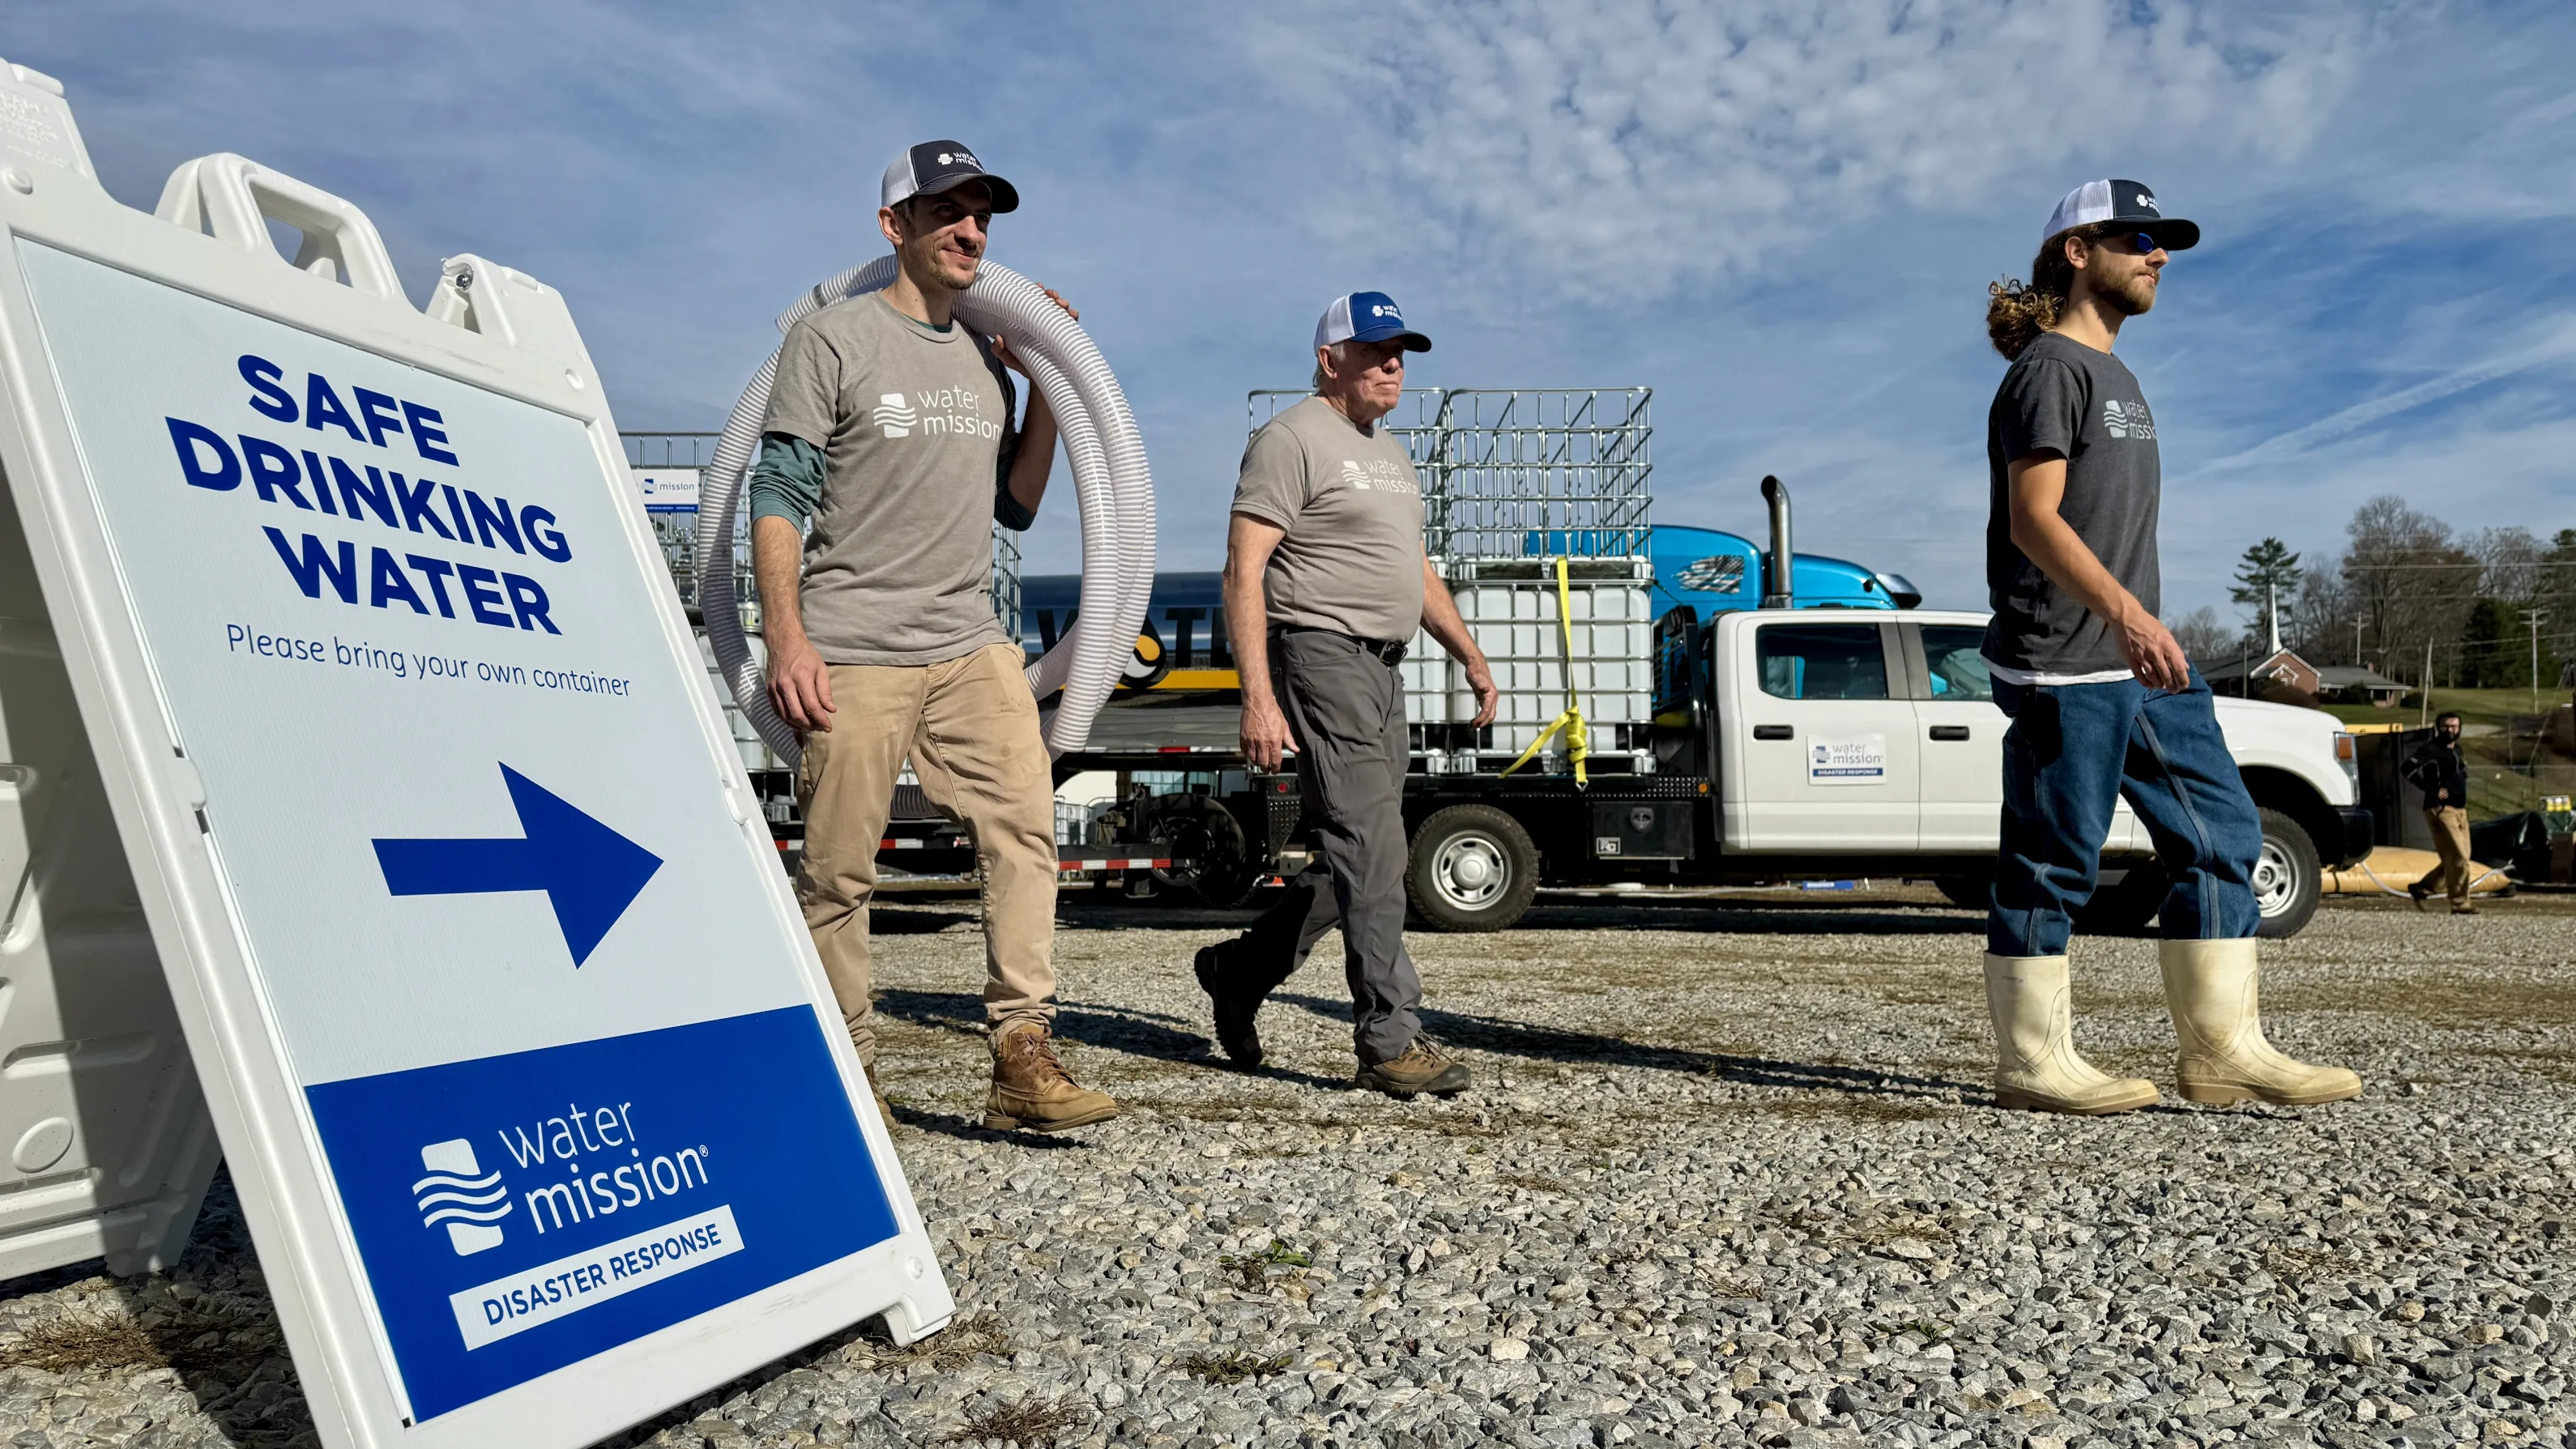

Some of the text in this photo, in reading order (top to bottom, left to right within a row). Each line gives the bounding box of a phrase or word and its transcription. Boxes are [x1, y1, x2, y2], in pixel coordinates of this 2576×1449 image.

[237, 354, 460, 467] SAFE
[917, 385, 979, 411] water
[2121, 399, 2148, 420] water
[923, 409, 1000, 442] mission
[2129, 419, 2156, 440] missi
[1363, 458, 1402, 477] water
[165, 416, 573, 564] DRINKING
[659, 482, 695, 491] mission
[1374, 475, 1419, 496] missio
[262, 526, 563, 636] WATER
[227, 624, 630, 697] Please bring your own container
[1832, 743, 1866, 753] water
[498, 1102, 636, 1169] water
[482, 1222, 723, 1326] DISASTER RESPONSE
